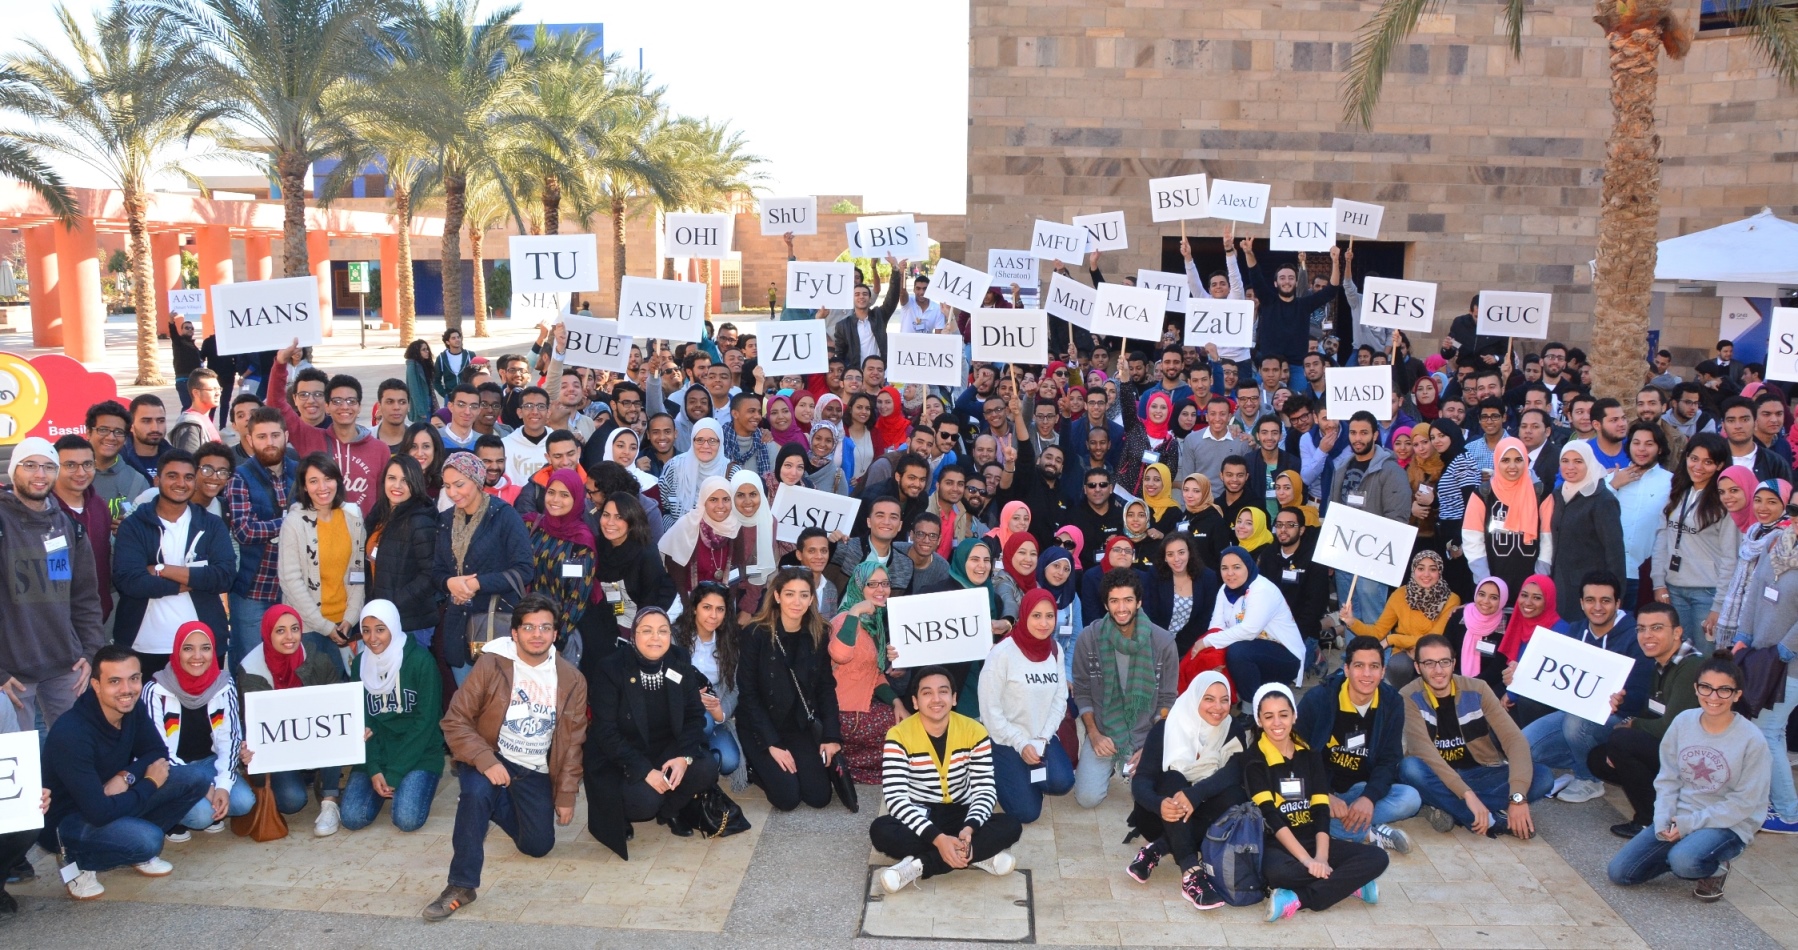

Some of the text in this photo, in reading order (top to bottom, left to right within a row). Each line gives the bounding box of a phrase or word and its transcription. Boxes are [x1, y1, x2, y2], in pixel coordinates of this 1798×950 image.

[1157, 187, 1200, 210] BSU
[1217, 193, 1259, 209] AlexU
[769, 208, 806, 223] ShU
[1343, 211, 1369, 226] PHI
[675, 226, 717, 246] OHI
[869, 225, 909, 248] BIS
[1278, 221, 1329, 238] AUN
[1036, 232, 1079, 253] MFU
[525, 251, 579, 281] TU
[994, 256, 1034, 270] AAST
[794, 272, 846, 300] FyU
[995, 270, 1031, 280] (Sheraton)
[937, 271, 974, 302] MA
[172, 293, 202, 303] AAST
[1053, 287, 1094, 317] MnU
[1372, 292, 1425, 320] KFS
[228, 302, 309, 329] MANS
[630, 301, 693, 321] ASWU
[1106, 302, 1149, 323] MCA
[1486, 306, 1540, 324] GUC
[1191, 310, 1245, 335] ZaU
[566, 330, 623, 358] BUE
[771, 332, 812, 362] ZU
[981, 325, 1036, 349] DhU
[1778, 333, 1798, 355] S
[897, 350, 955, 368] IAEMS
[1334, 385, 1385, 402] MASD
[779, 504, 844, 533] ASU
[1329, 525, 1396, 567] NCA
[49, 559, 68, 572] TAR
[902, 615, 980, 645] NBSU
[1532, 655, 1605, 699] PSU
[366, 684, 418, 717] GAP
[260, 712, 353, 745] MUST
[521, 719, 537, 735] 68
[1330, 752, 1361, 770] SAMS
[1682, 749, 1724, 771] CONVERSE
